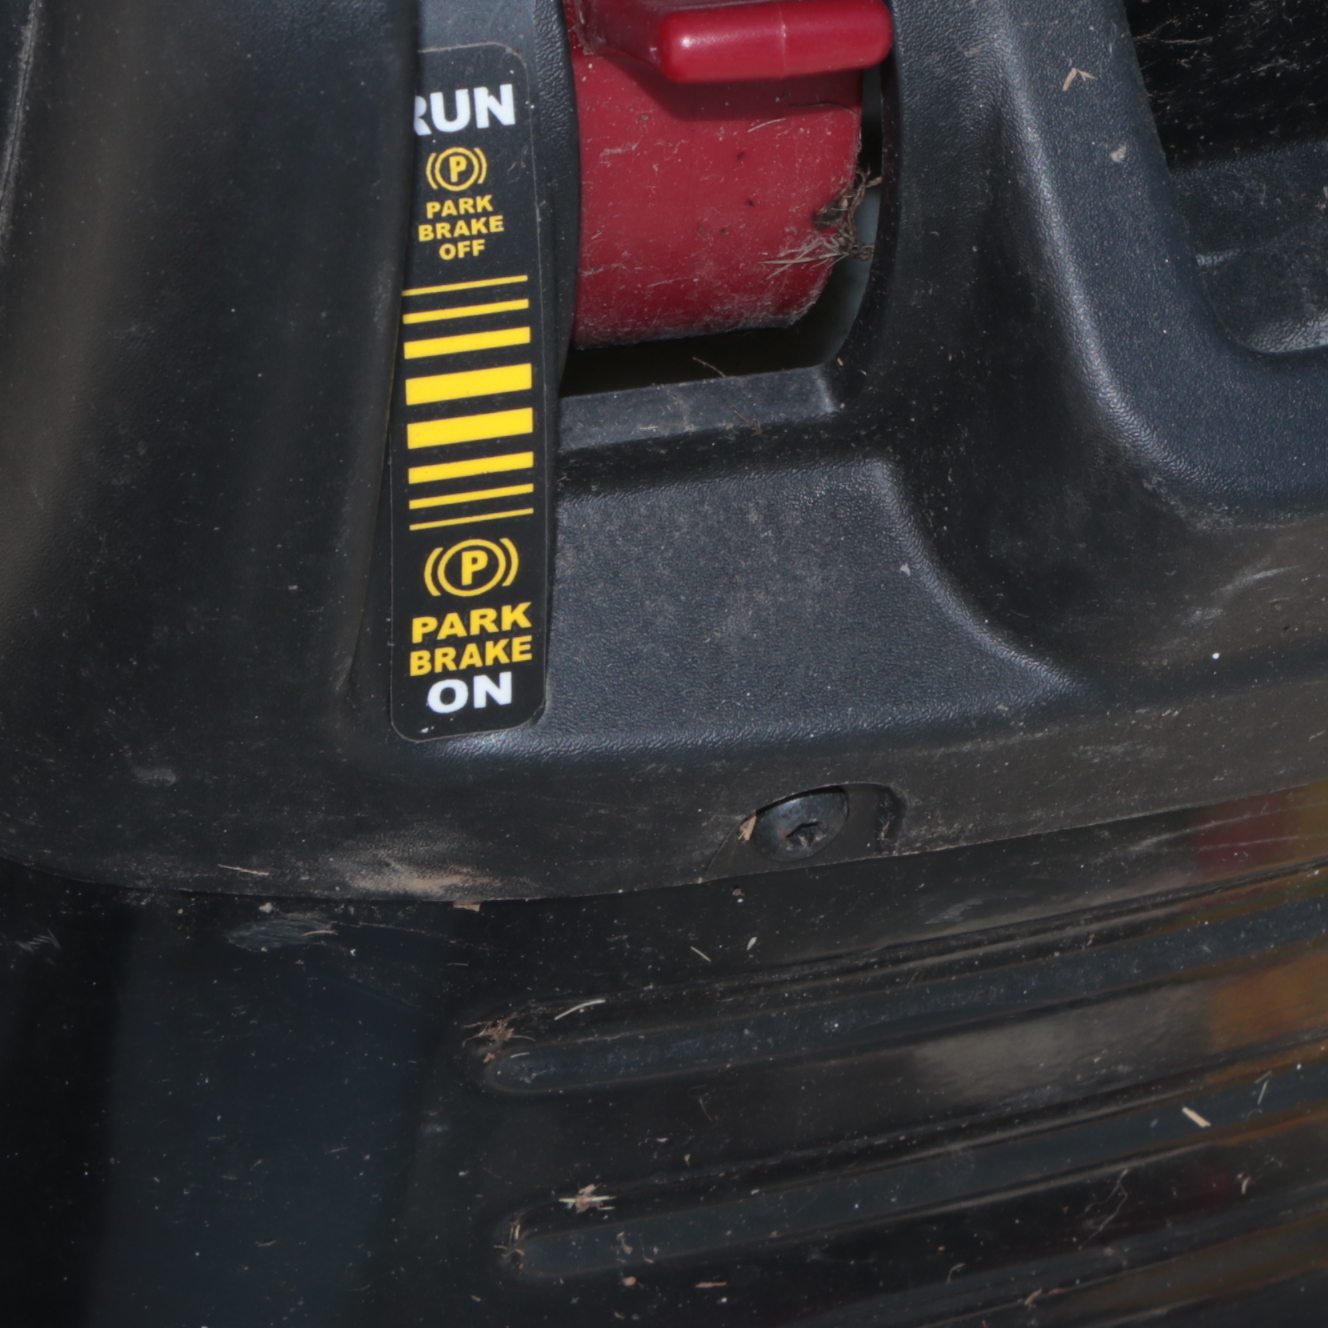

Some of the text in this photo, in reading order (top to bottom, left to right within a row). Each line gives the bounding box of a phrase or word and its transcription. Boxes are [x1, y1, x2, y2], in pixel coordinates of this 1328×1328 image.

[426, 194, 494, 220] PARK
[418, 215, 505, 242] BRAKE
[439, 239, 486, 260] OFF
[412, 601, 533, 644] PARK
[410, 634, 533, 677] BRAKE
[427, 671, 513, 714] ON
